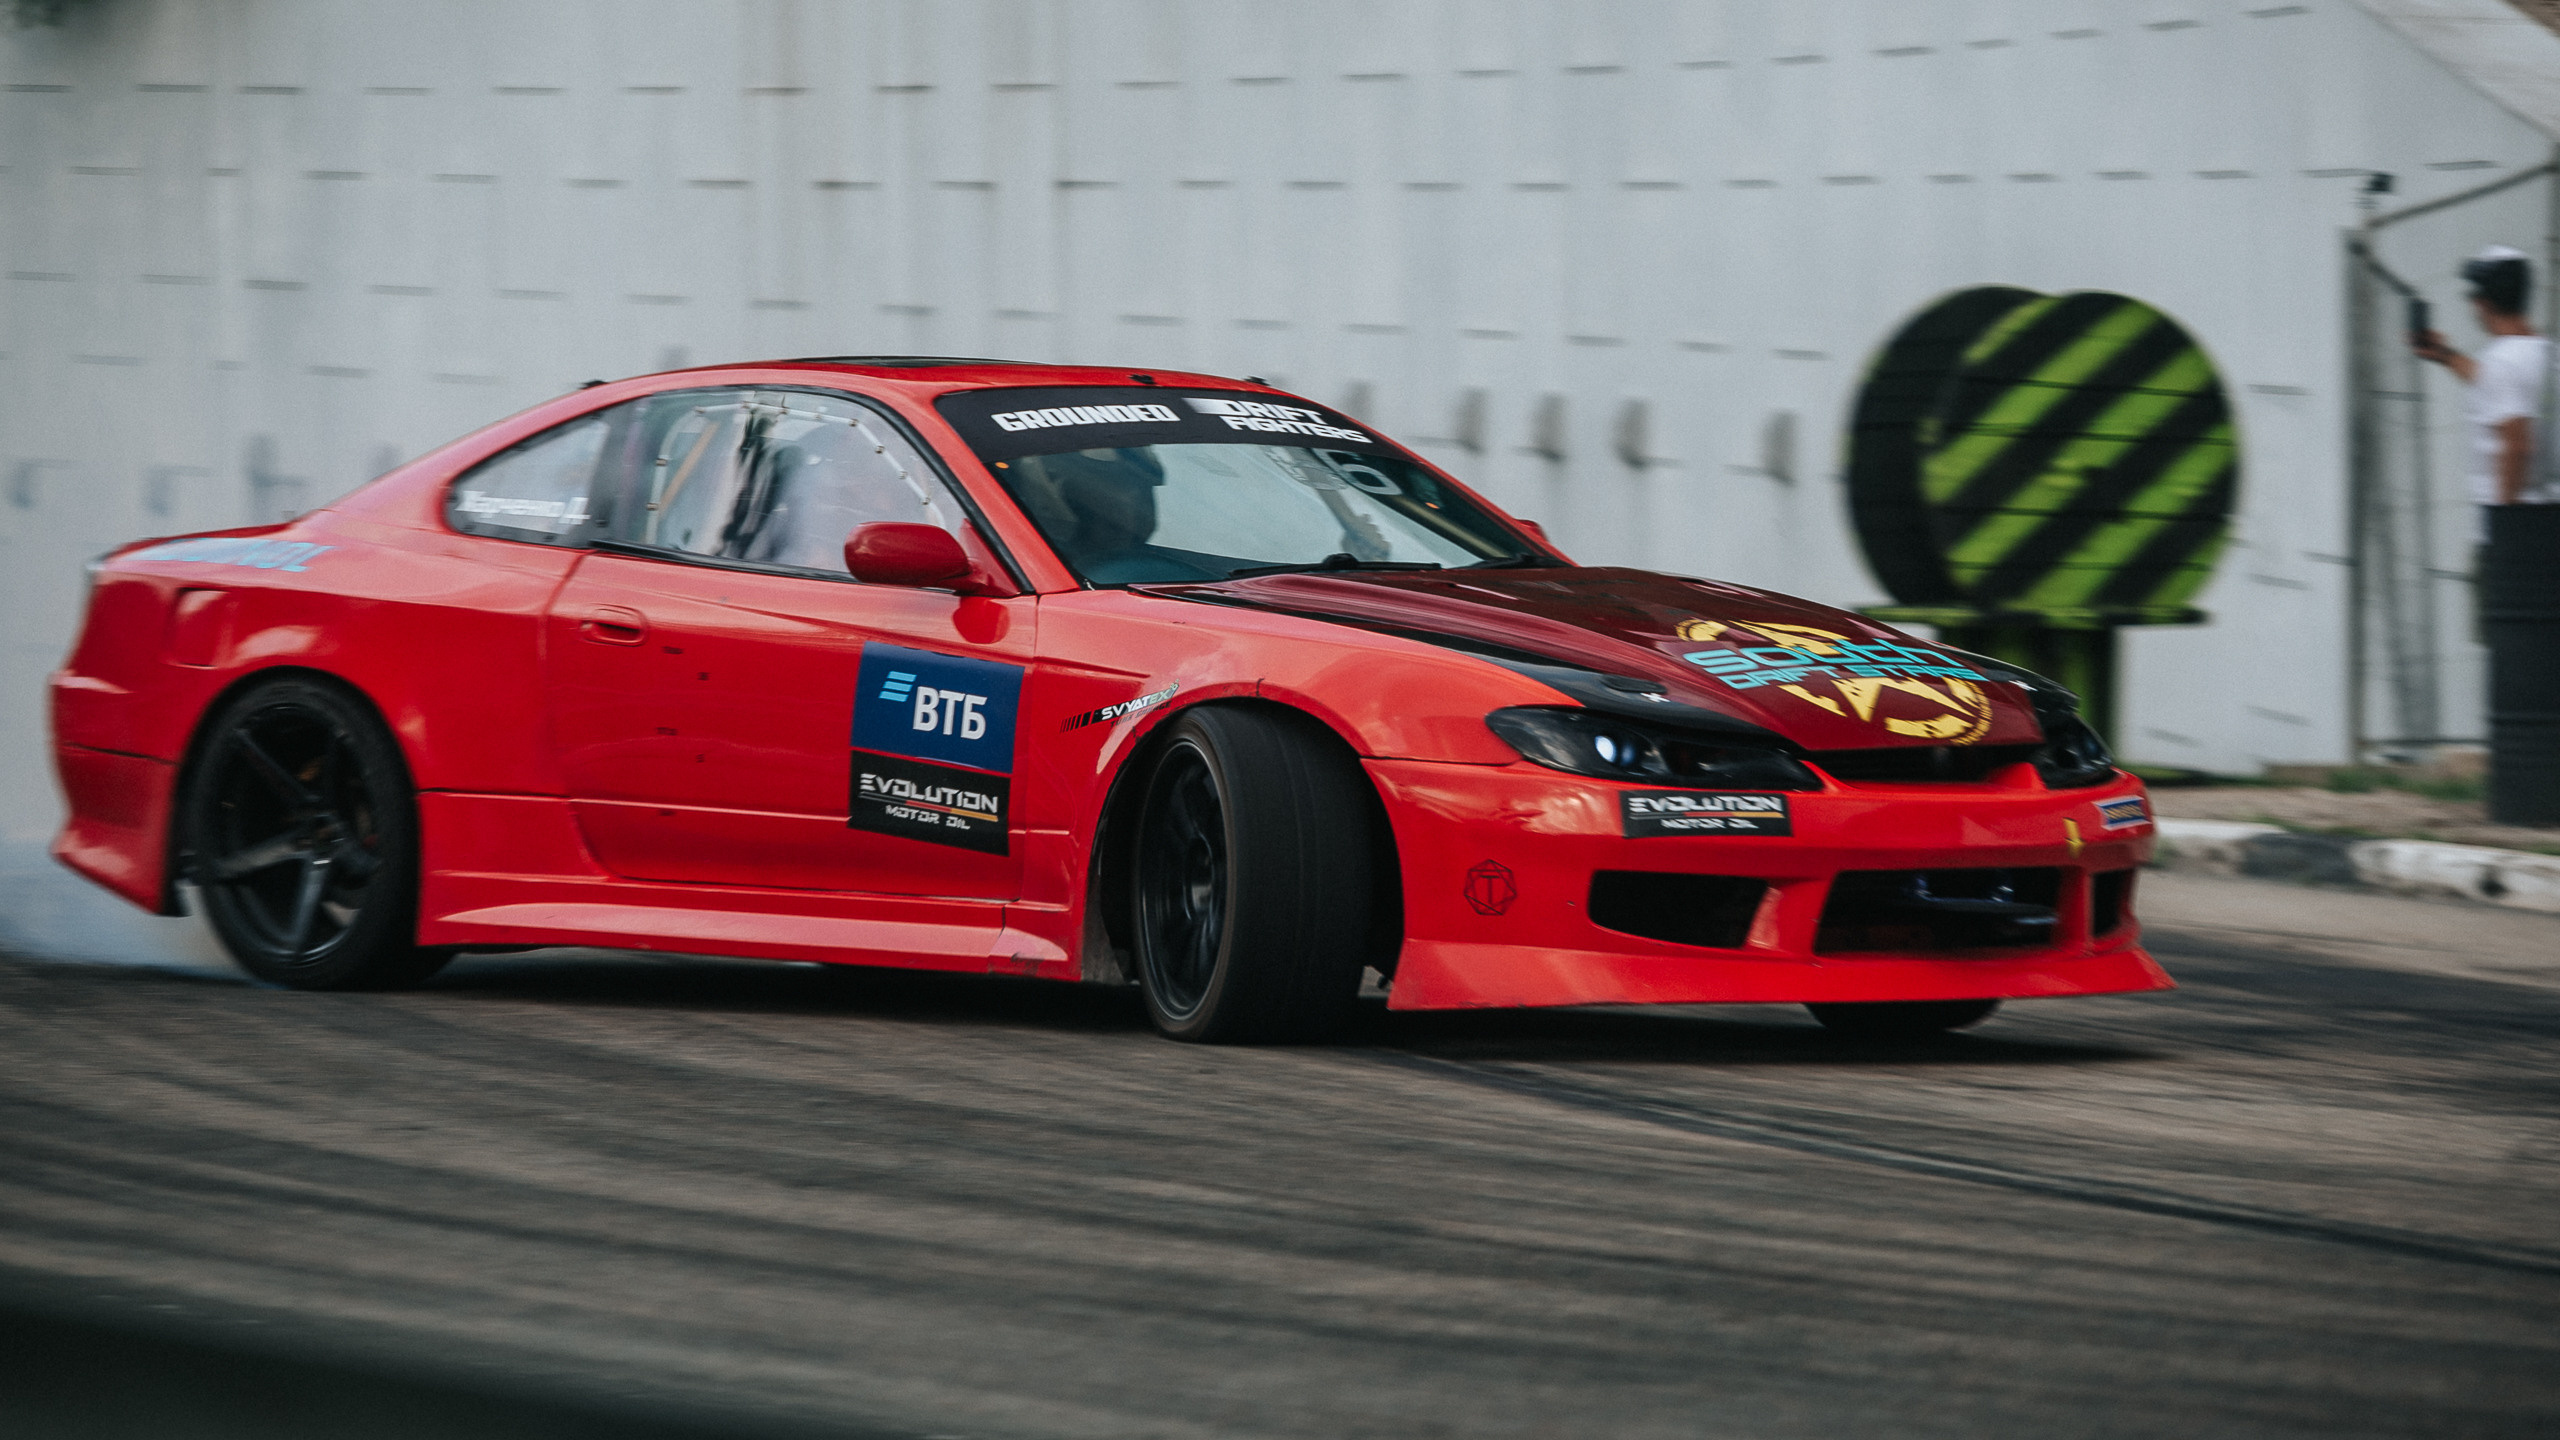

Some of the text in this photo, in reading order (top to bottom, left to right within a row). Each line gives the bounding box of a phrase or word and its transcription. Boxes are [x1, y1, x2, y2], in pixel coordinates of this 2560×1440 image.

[991, 404, 1181, 432] GROUNDED
[1221, 398, 1329, 426] DRIFT
[1219, 415, 1374, 444] FIGHTERS
[1717, 665, 1841, 690] DRIFT
[912, 686, 988, 740] ВТБ
[1101, 687, 1174, 721] SVYATEX
[860, 773, 999, 814] EVOLUTION
[1628, 795, 1783, 812] EVOLUTION
[885, 804, 971, 830] MOTOR OIL
[1660, 818, 1727, 829] MOTOR
